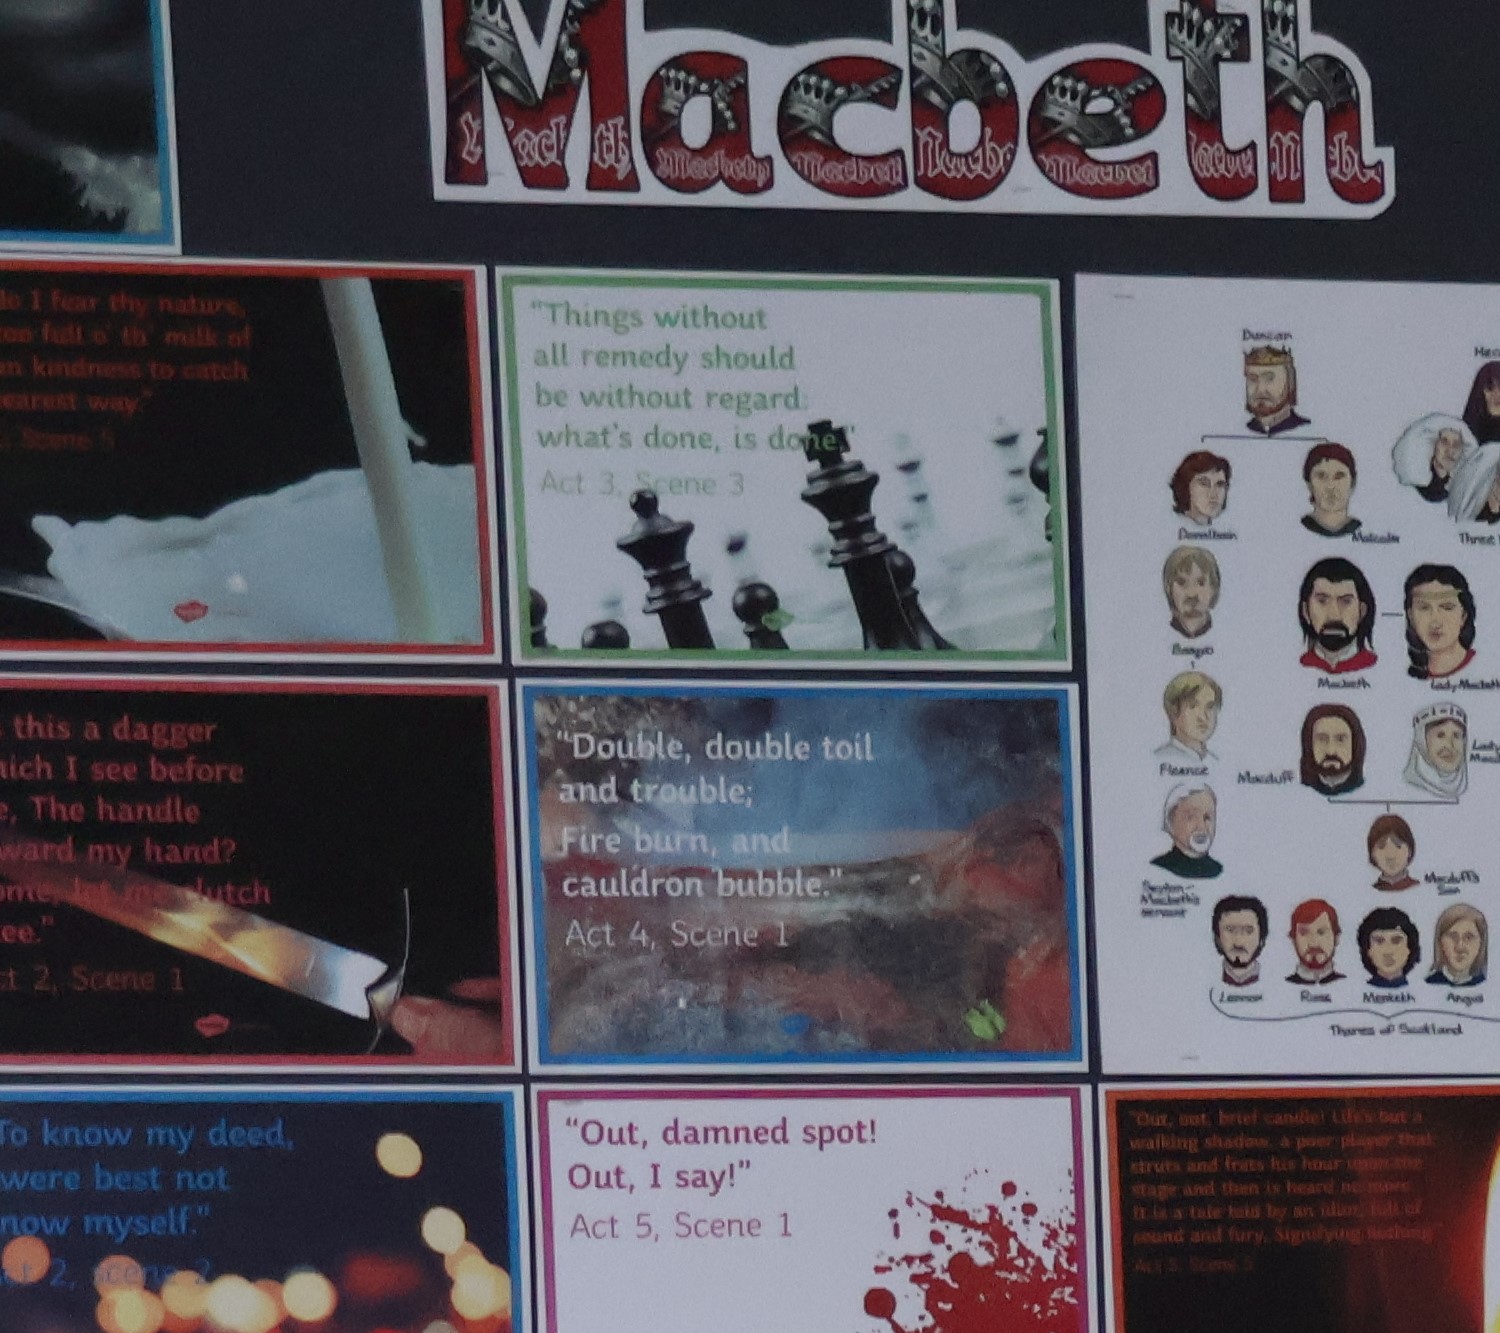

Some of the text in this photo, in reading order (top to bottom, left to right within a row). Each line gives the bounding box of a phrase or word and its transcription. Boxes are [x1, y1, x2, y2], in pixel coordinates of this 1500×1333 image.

[444, 0, 1386, 204] Macbeth
[654, 304, 768, 330] without
[533, 342, 796, 376] all remedy should
[536, 382, 693, 410] be without
[537, 422, 757, 454] what's done, is
[540, 469, 745, 496] Act Scene 3
[14, 713, 218, 750] this dagger
[705, 731, 812, 762] double
[823, 731, 875, 762] toil
[90, 755, 245, 783] see before
[558, 775, 754, 808] and trouble;
[30, 795, 201, 824] The handle
[88, 837, 238, 870] my hand?
[560, 826, 791, 858] Fire burn, and
[562, 869, 704, 898] cauldron
[565, 919, 789, 950] Act 4, Scene 1
[72, 965, 156, 992] Scene
[42, 1117, 295, 1156] know my deed,
[662, 1116, 790, 1146] damned
[802, 1119, 877, 1151] spot!
[94, 1162, 231, 1192] best not
[568, 1163, 635, 1194] Out,
[650, 1163, 661, 1188] I
[570, 1211, 793, 1243] Act 5, Scene 1
